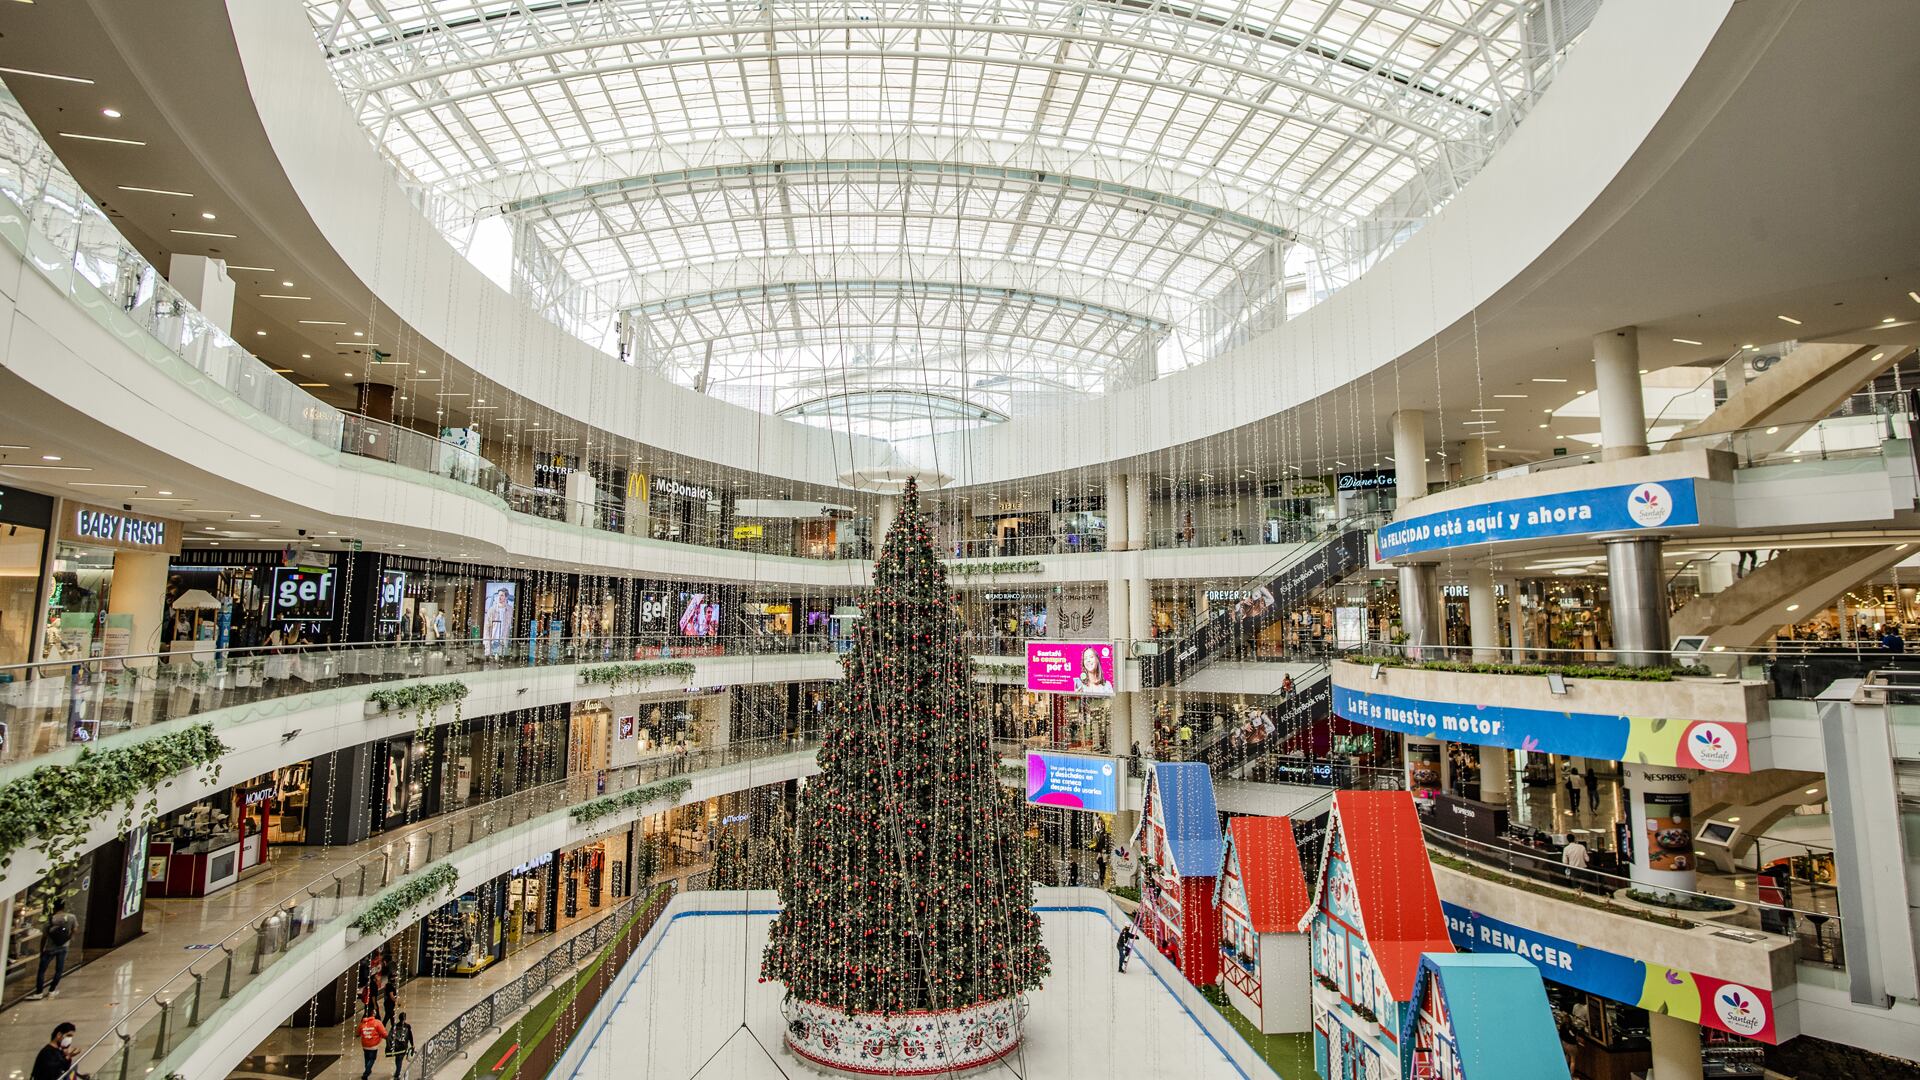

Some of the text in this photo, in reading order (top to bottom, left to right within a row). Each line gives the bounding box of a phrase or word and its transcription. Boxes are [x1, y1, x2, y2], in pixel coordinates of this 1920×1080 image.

[655, 478, 713, 501] McDonald's
[78, 510, 165, 545] BABY FRESH
[1387, 525, 1430, 547] FELICIDAD
[1433, 518, 1463, 538] está
[1467, 512, 1503, 533] aquí
[1509, 512, 1520, 530] y
[1527, 505, 1592, 526] ahora
[278, 572, 333, 607] gef
[1205, 590, 1239, 600] FOREVER
[642, 595, 669, 623] gef
[284, 623, 321, 634] MEN
[1063, 662, 1072, 671] ti
[1348, 697, 1501, 736] La FE es nuestro motor
[1452, 803, 1476, 818] NESPRESSO
[1480, 925, 1573, 972] RENACER
